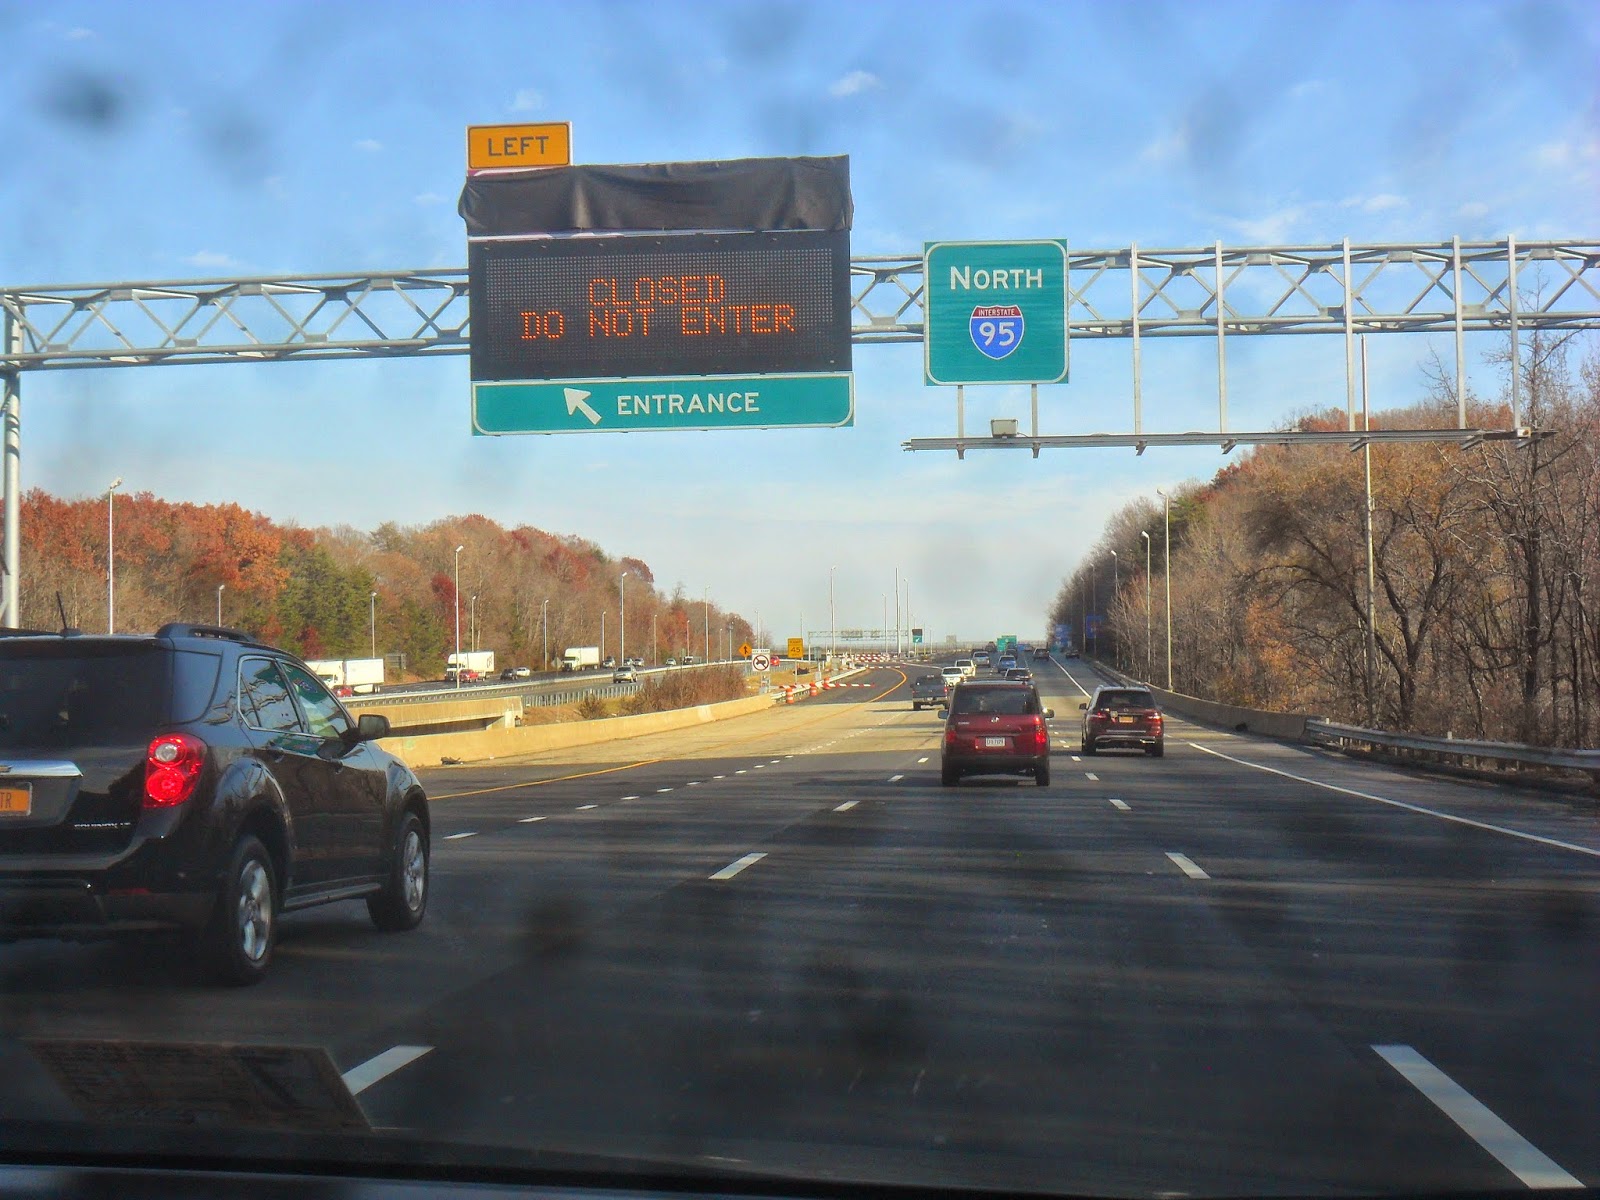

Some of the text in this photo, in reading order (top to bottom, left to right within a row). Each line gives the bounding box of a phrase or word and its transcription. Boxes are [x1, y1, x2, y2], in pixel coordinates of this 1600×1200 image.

[487, 136, 550, 157] LEFT
[950, 265, 1043, 290] NORTH
[588, 274, 726, 307] CLOSED
[520, 303, 796, 340] DO NOT ENTER
[978, 308, 1016, 317] INTERSTATE
[979, 322, 1015, 347] 95
[616, 392, 761, 416] ENTRANCE
